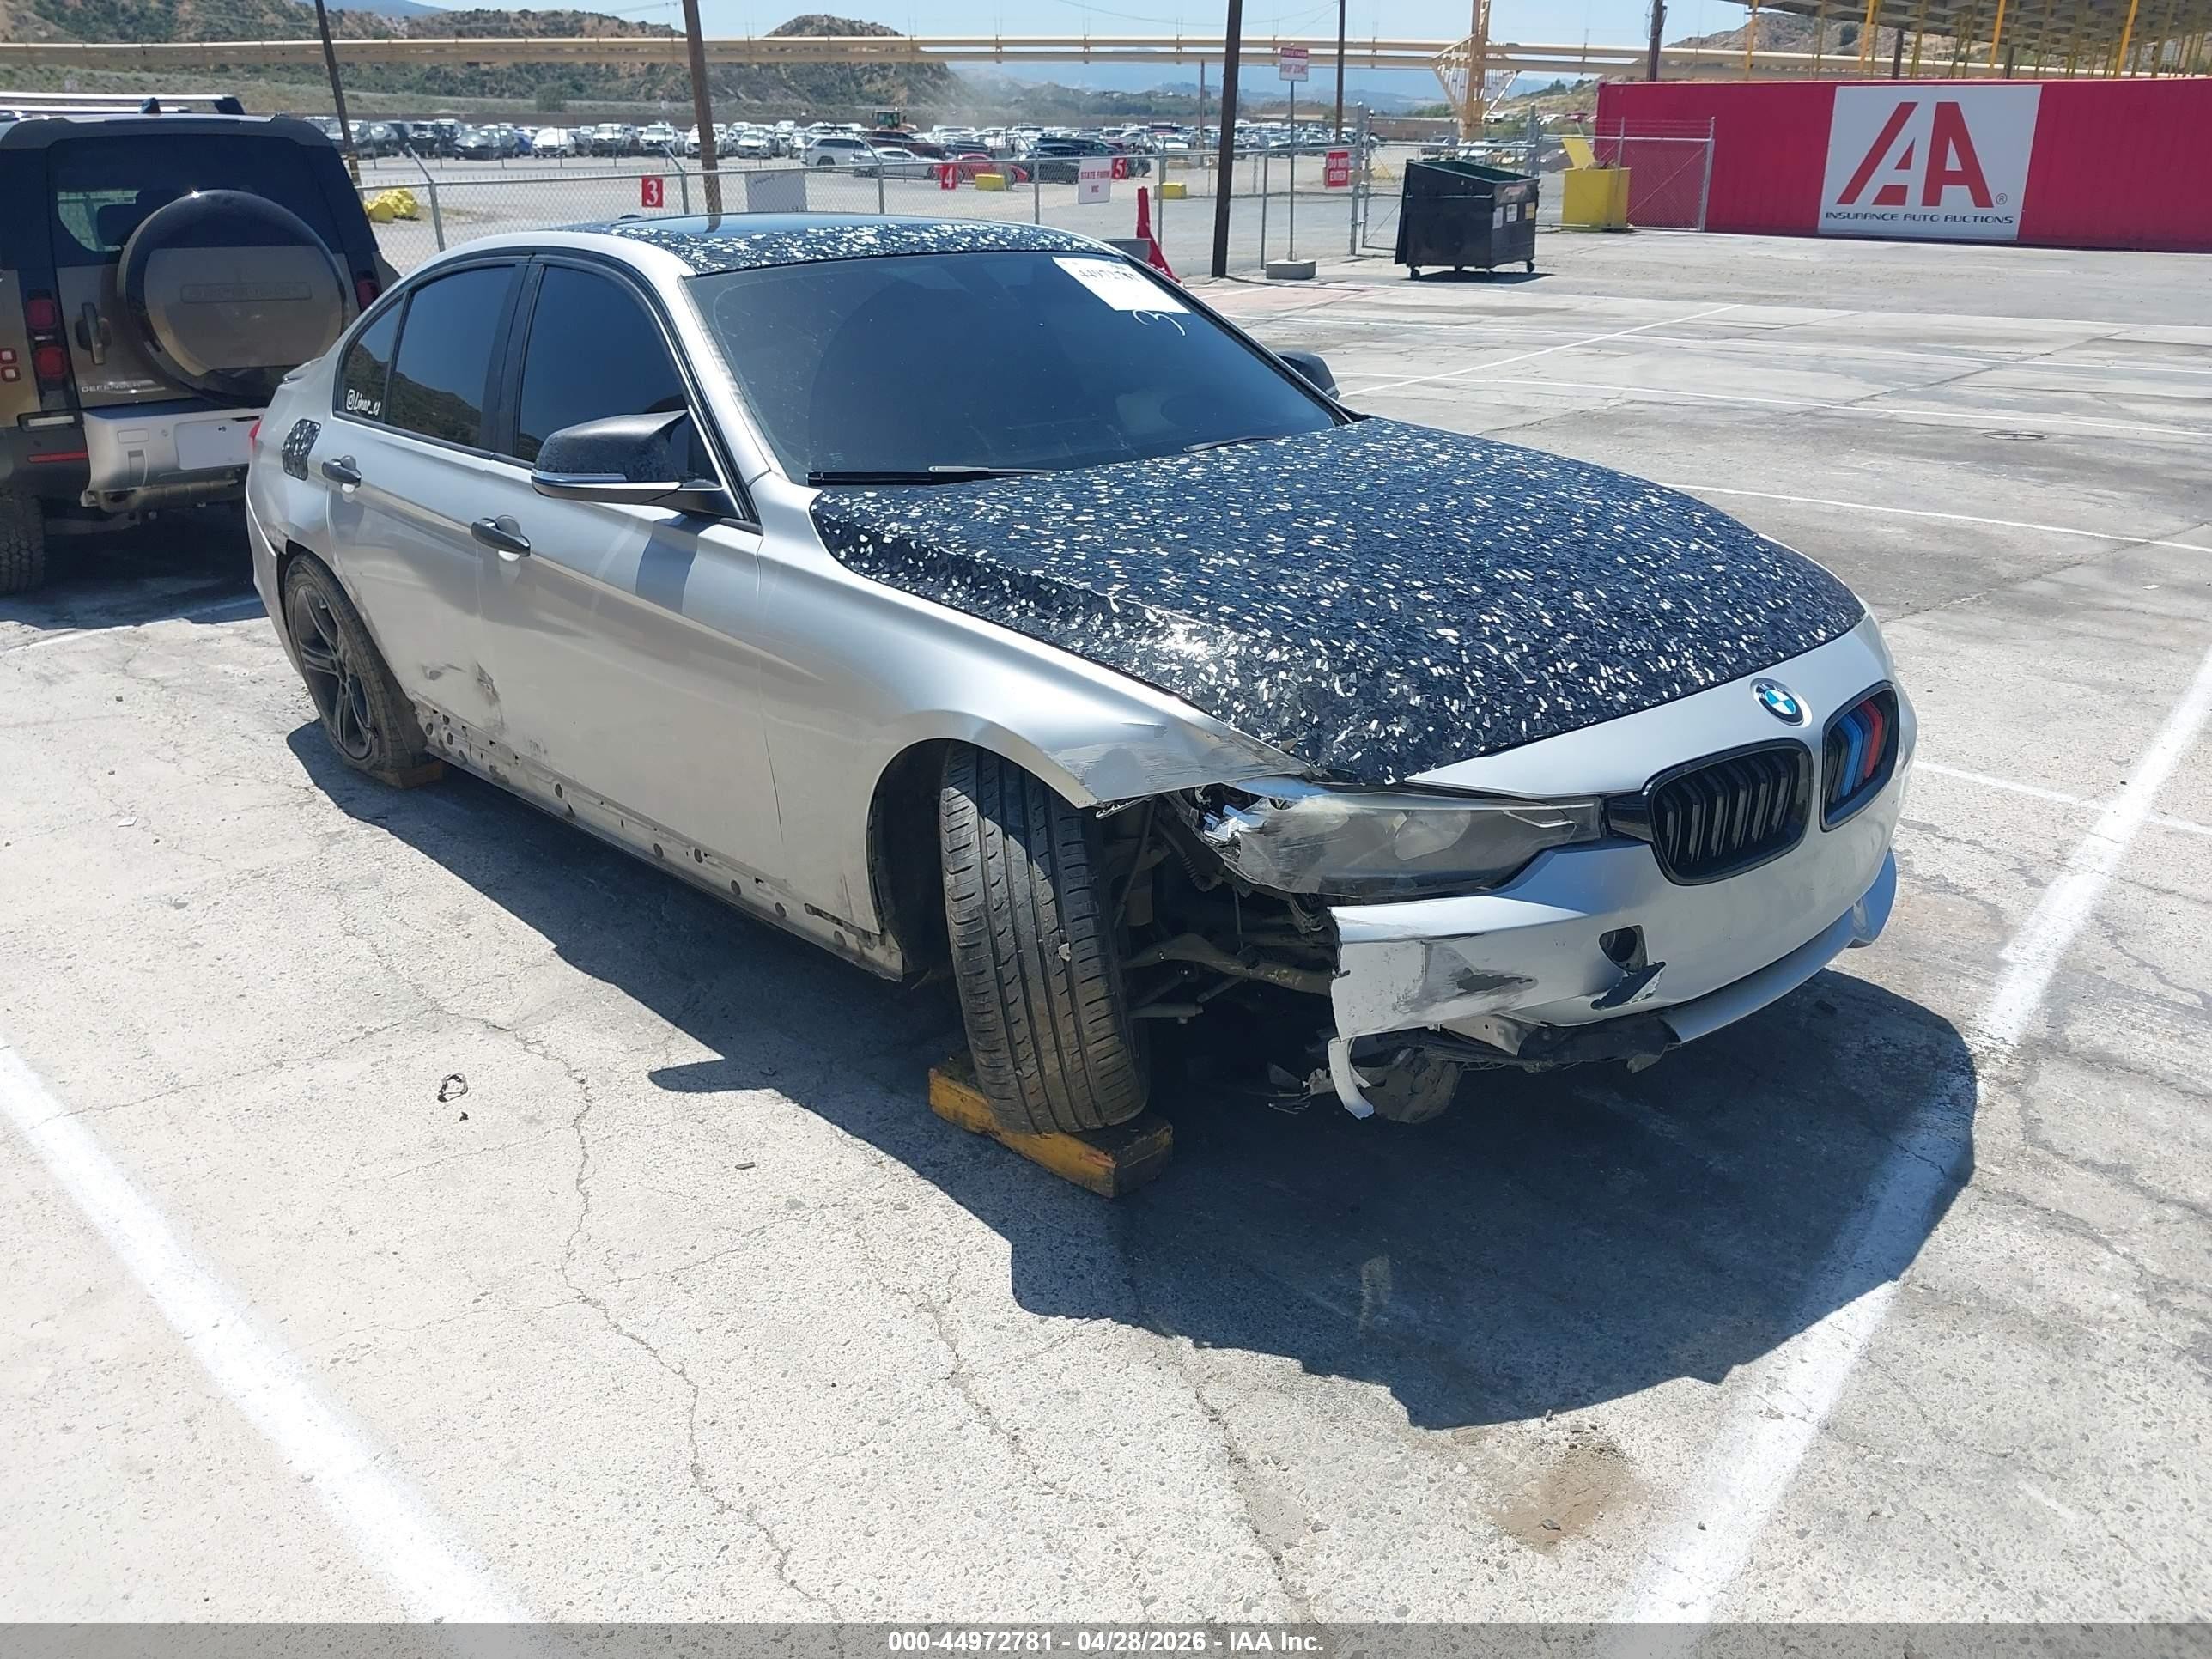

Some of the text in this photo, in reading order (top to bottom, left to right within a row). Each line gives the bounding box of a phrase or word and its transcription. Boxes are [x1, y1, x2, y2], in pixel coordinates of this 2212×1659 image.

[945, 167, 953, 188] 4
[1115, 159, 1124, 179] 5
[646, 180, 659, 206] 3
[1826, 211, 2014, 224] INSURANCE AUTO AUCTIONS
